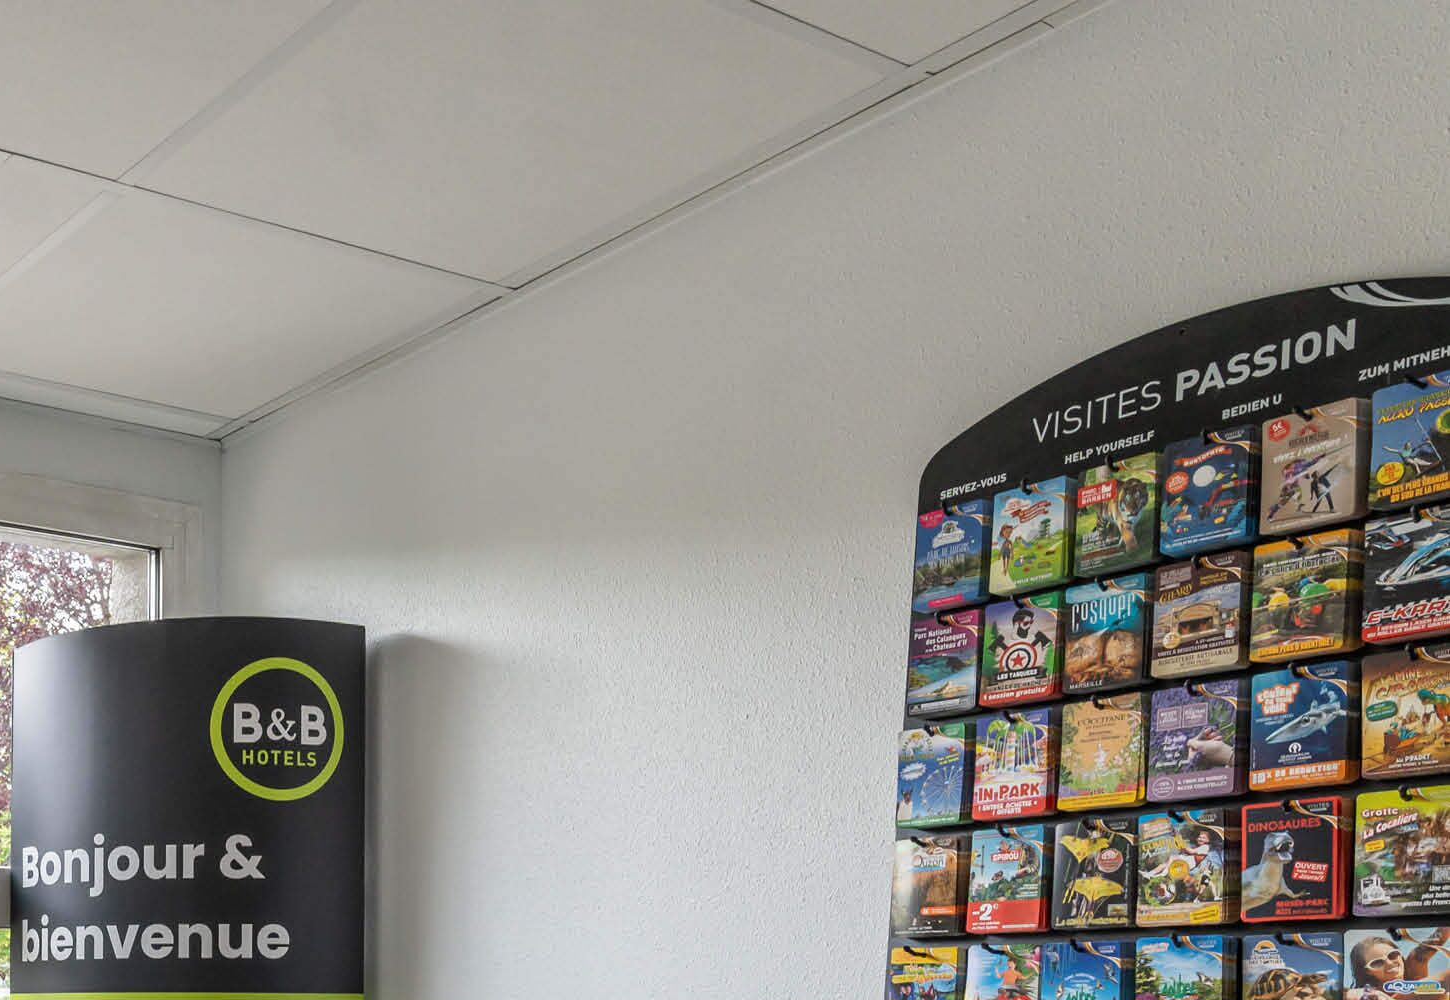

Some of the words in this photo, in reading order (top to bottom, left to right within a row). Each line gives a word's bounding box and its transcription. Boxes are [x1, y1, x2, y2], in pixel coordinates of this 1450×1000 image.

[1032, 379, 1162, 444] VISITES
[1175, 318, 1357, 402] PASSION
[1358, 362, 1390, 382] ZUM
[1222, 396, 1270, 420] BEDIEN
[1272, 393, 1283, 405] U
[1064, 447, 1094, 465] HELP
[1095, 430, 1156, 457] YOURSELF
[939, 473, 1008, 501] SERVEZ-VOUS
[1365, 595, 1450, 626] E-KAR
[928, 627, 952, 638] National
[936, 632, 967, 645] Calanques
[997, 672, 1009, 681] LES
[1069, 680, 1103, 689] MARSEILLE
[988, 690, 1015, 700] session
[233, 702, 328, 747] B&B
[241, 749, 318, 768] HOTELS
[998, 782, 1040, 799] PARK
[1361, 807, 1399, 818] Grotte
[1247, 817, 1322, 833] DINOSAURES
[1363, 828, 1375, 840] La
[1375, 812, 1419, 834] Cocalière
[22, 832, 206, 898] Bonjour
[219, 834, 267, 880] &
[991, 852, 1019, 863] SPIROU
[1294, 861, 1329, 872] OUVERT
[21, 914, 291, 962] bienvenue
